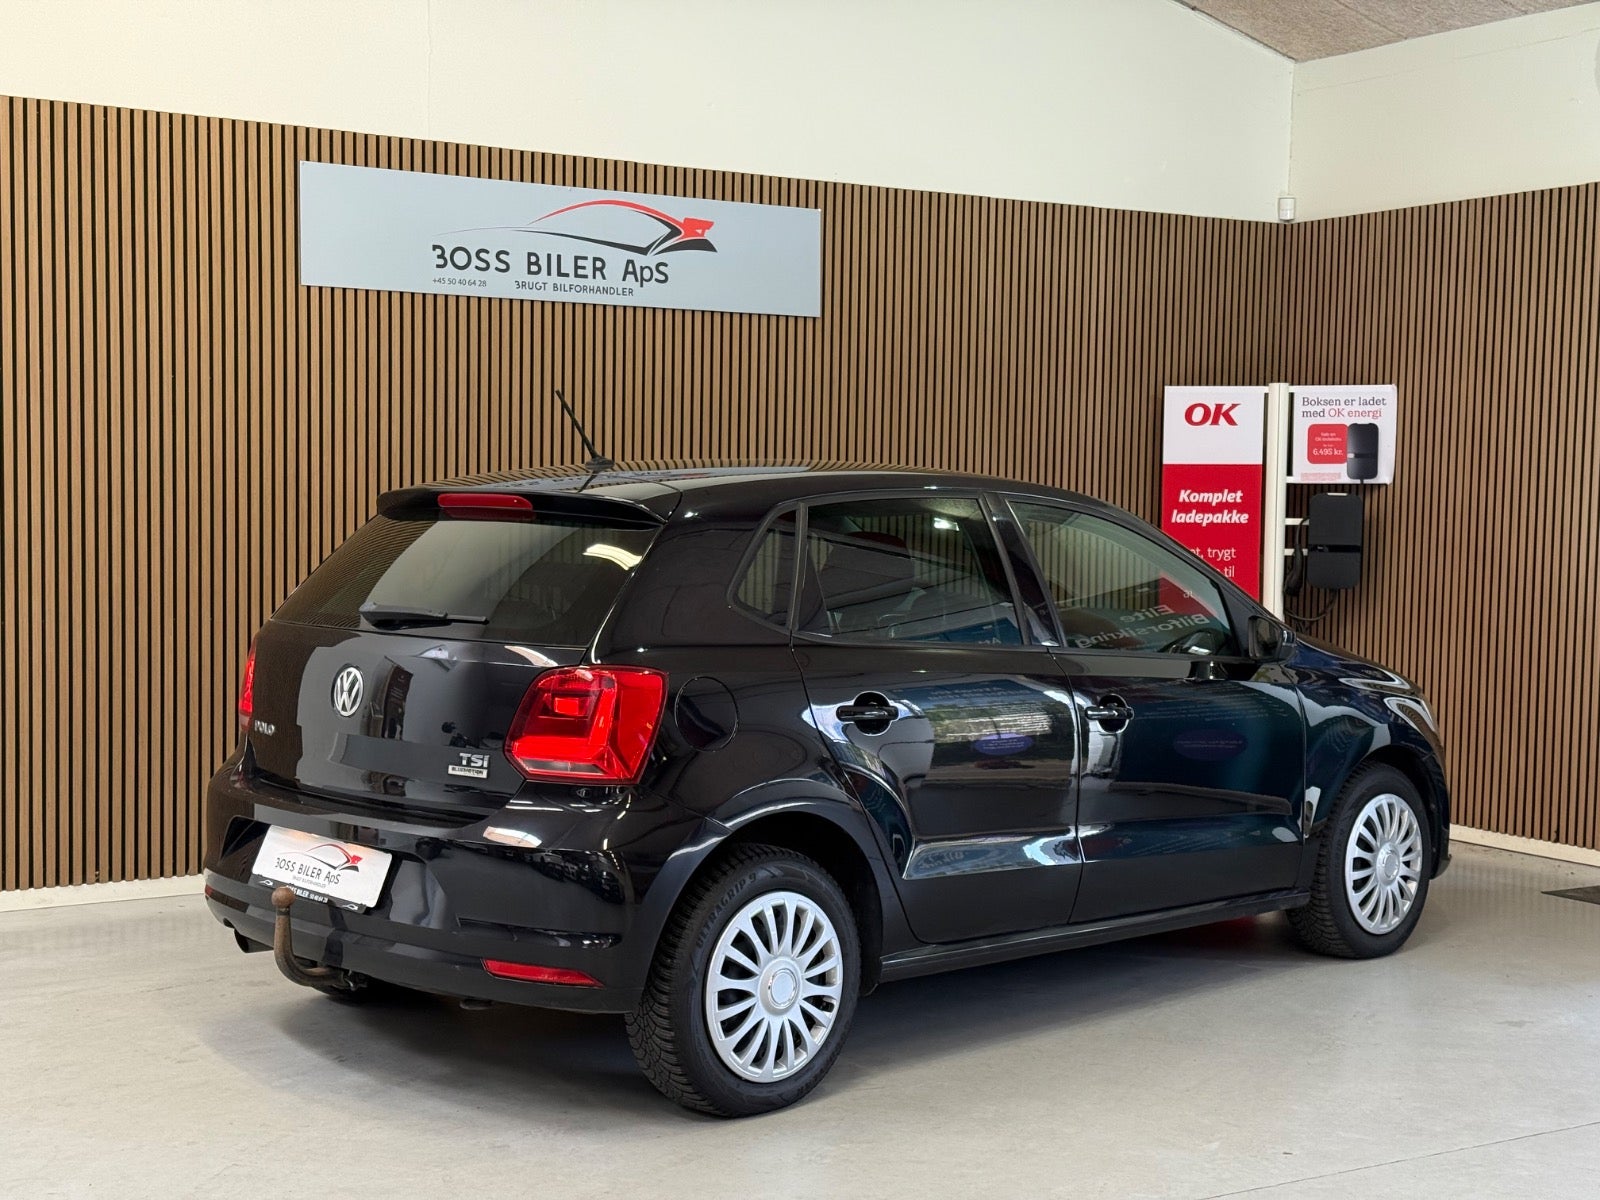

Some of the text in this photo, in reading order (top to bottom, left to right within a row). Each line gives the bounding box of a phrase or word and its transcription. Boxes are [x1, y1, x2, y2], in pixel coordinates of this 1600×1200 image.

[432, 244, 669, 288] BOSS BILER ApS
[432, 277, 487, 288] +45 50 40 64 28
[514, 280, 634, 297] BRUGT BILFORHANDLER
[1302, 396, 1387, 406] Boksen er ladet
[1184, 402, 1241, 426] OK
[1302, 408, 1382, 420] med OK energi
[1178, 489, 1243, 507] Komplet
[1171, 509, 1249, 527] ladepakke
[1207, 547, 1236, 561] trygt
[1224, 565, 1235, 577] til
[254, 719, 276, 737] POLO
[297, 863, 322, 881] BILER
[323, 871, 341, 885] ApS
